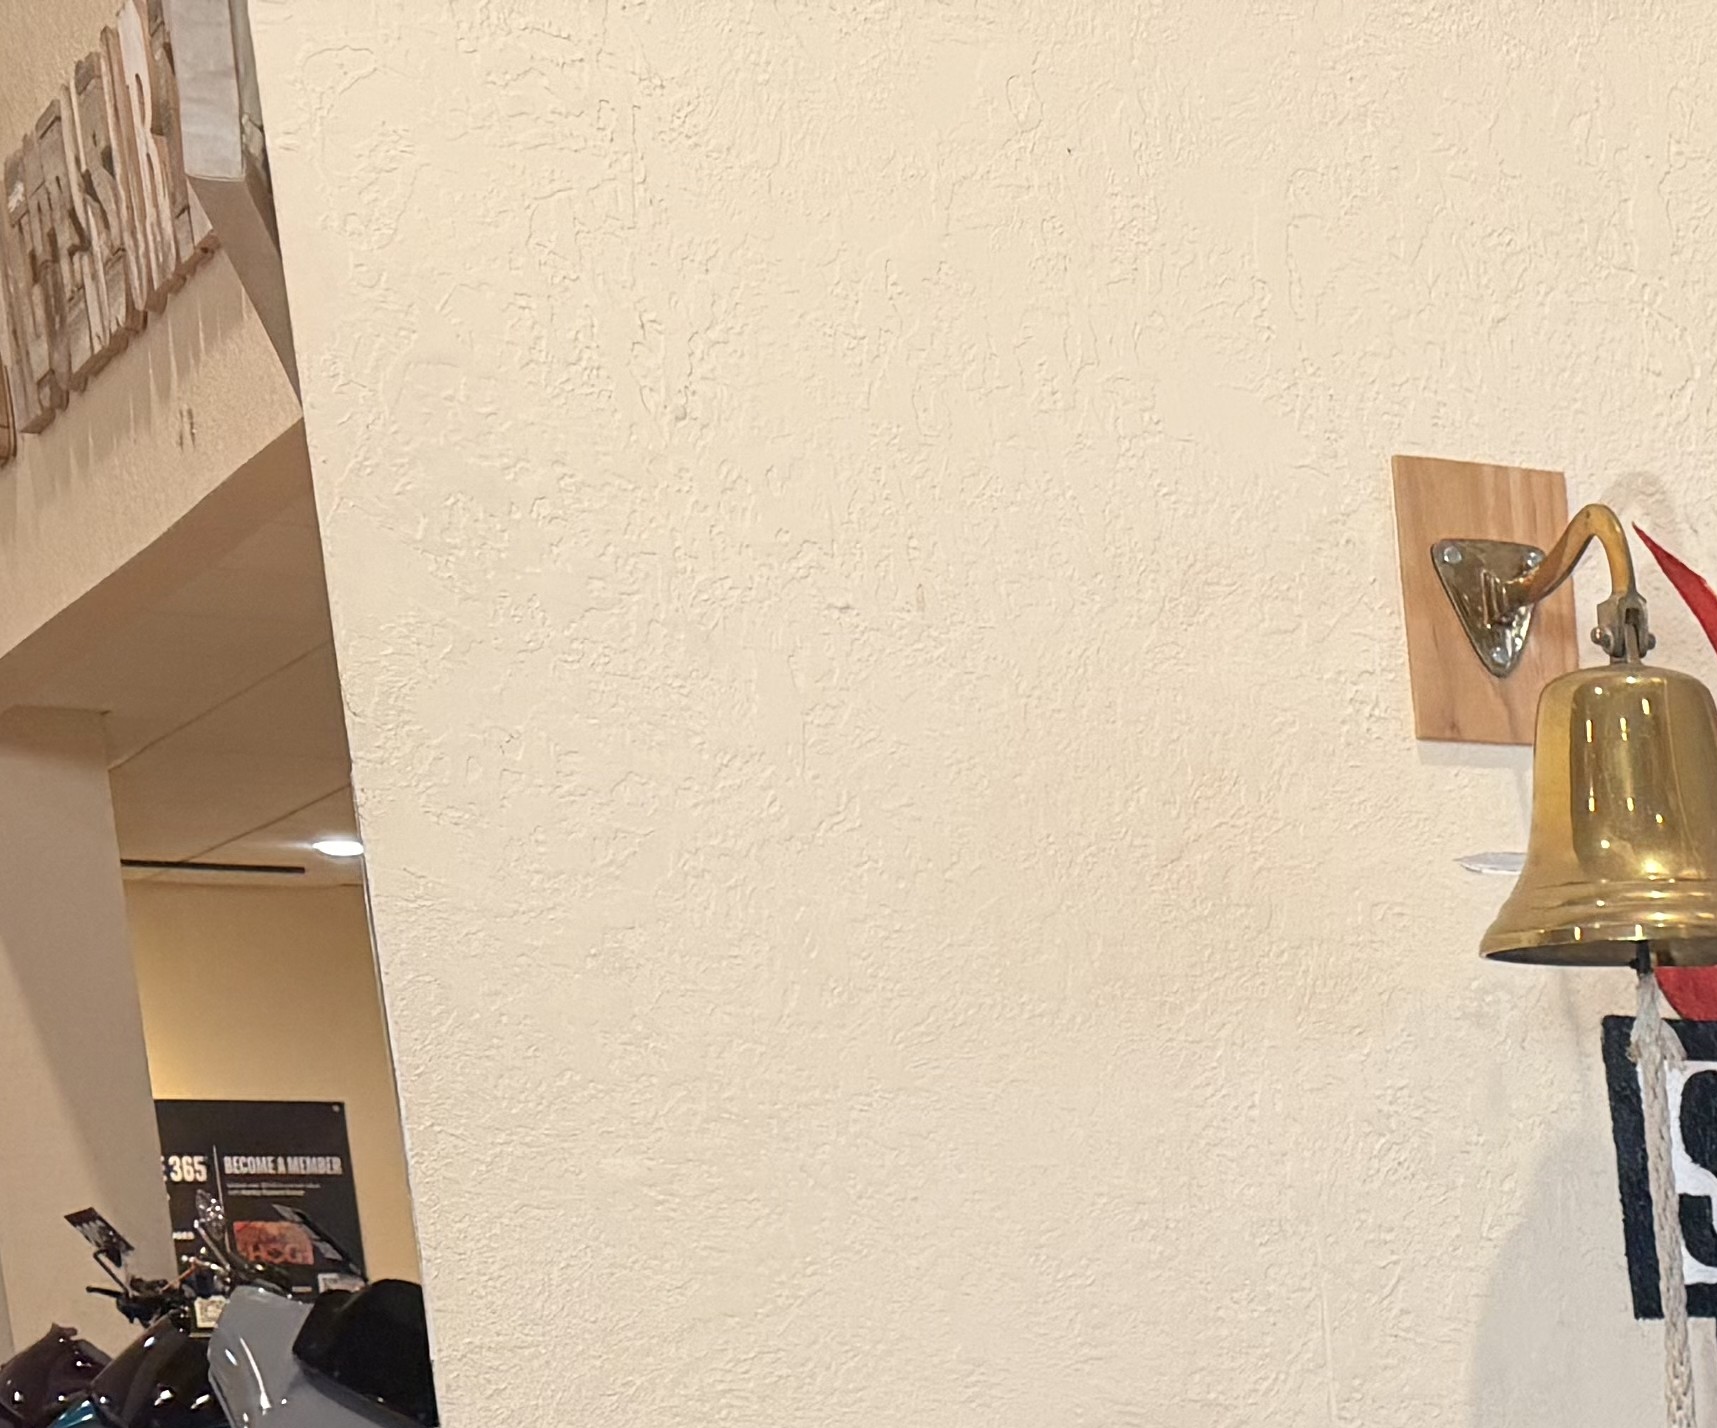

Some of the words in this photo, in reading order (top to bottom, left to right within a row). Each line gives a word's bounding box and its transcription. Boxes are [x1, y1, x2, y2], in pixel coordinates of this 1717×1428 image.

[168, 1155, 207, 1182] 365
[223, 1156, 276, 1174] BECOME
[277, 1156, 286, 1174] A
[287, 1156, 342, 1175] MEMBER
